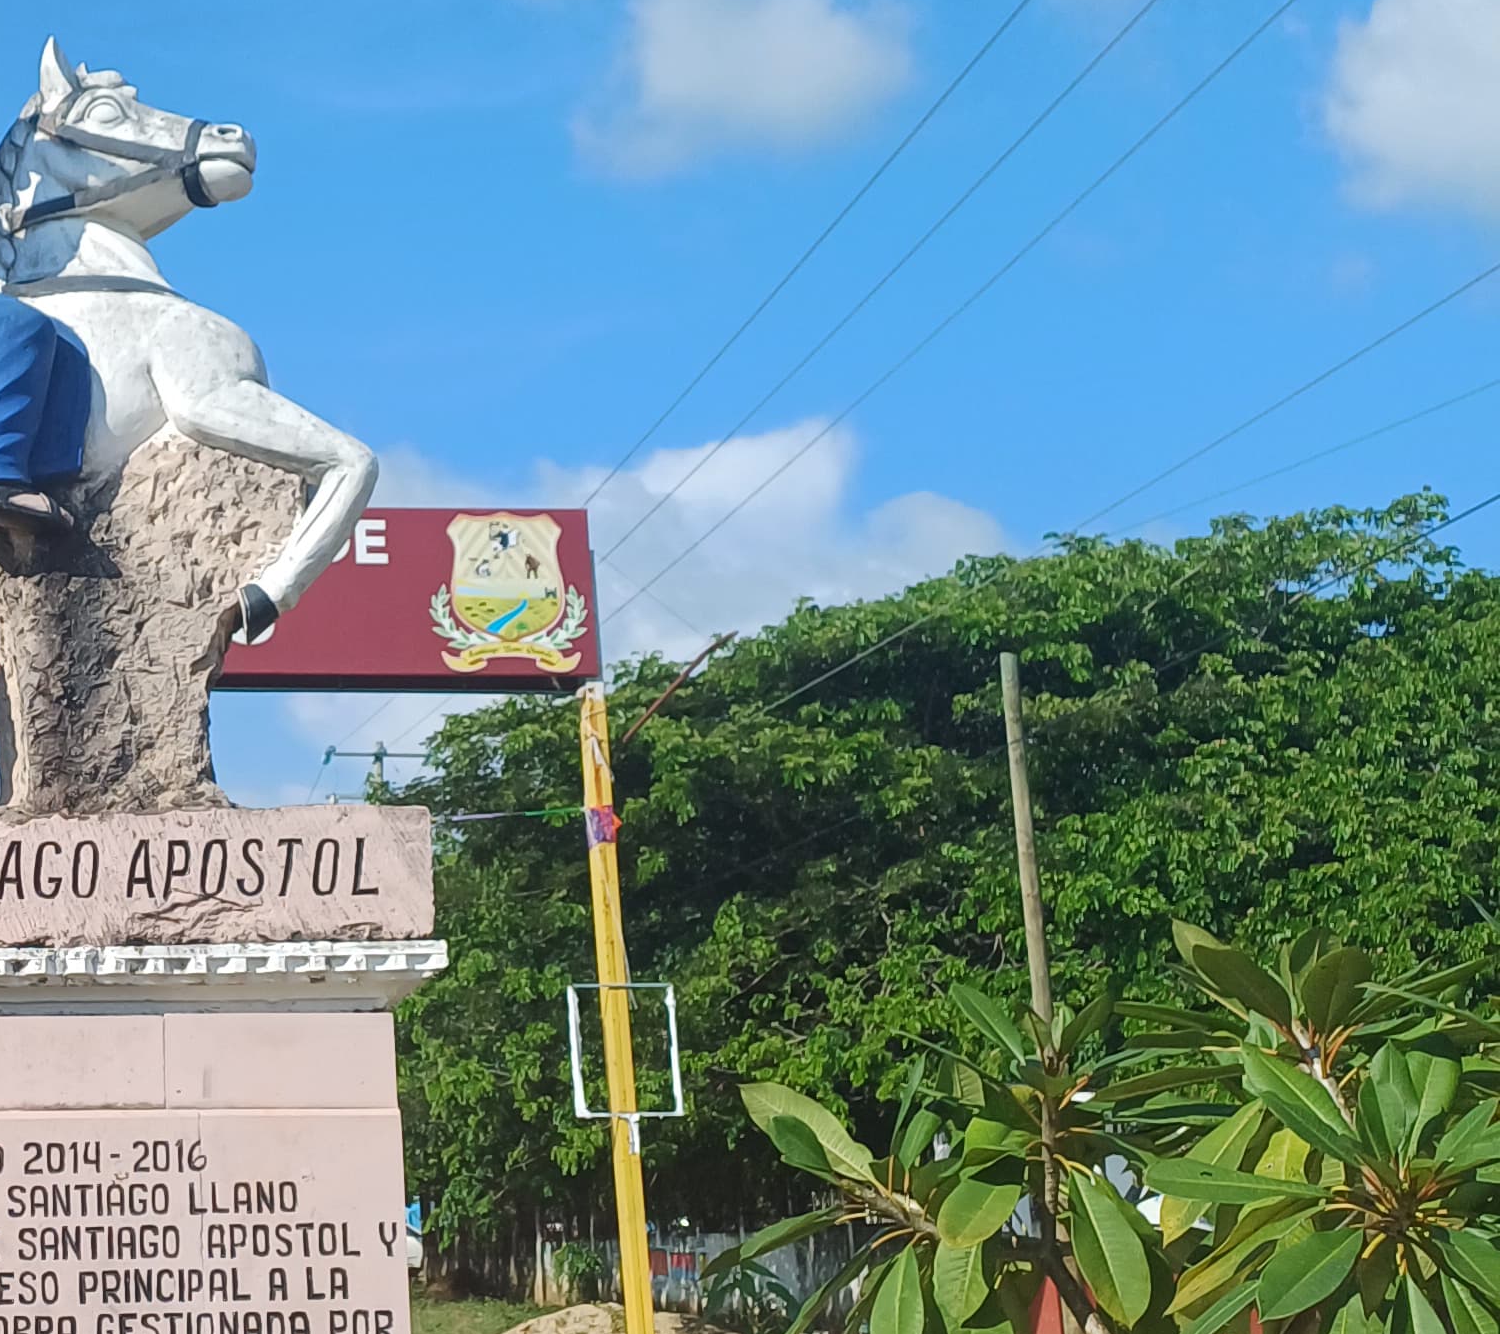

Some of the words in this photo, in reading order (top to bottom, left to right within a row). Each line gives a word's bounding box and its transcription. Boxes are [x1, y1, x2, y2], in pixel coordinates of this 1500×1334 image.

[126, 837, 380, 901] APOSTOL
[7, 1181, 170, 1219] SANTIAGO
[188, 1180, 299, 1216] LLANO
[18, 1224, 181, 1262] SANTIAGO
[206, 1221, 361, 1260] APOSTOL
[378, 1220, 399, 1257] Y
[78, 1267, 252, 1305] PRINCIPAL
[268, 1267, 290, 1302] A
[305, 1266, 350, 1301] LA
